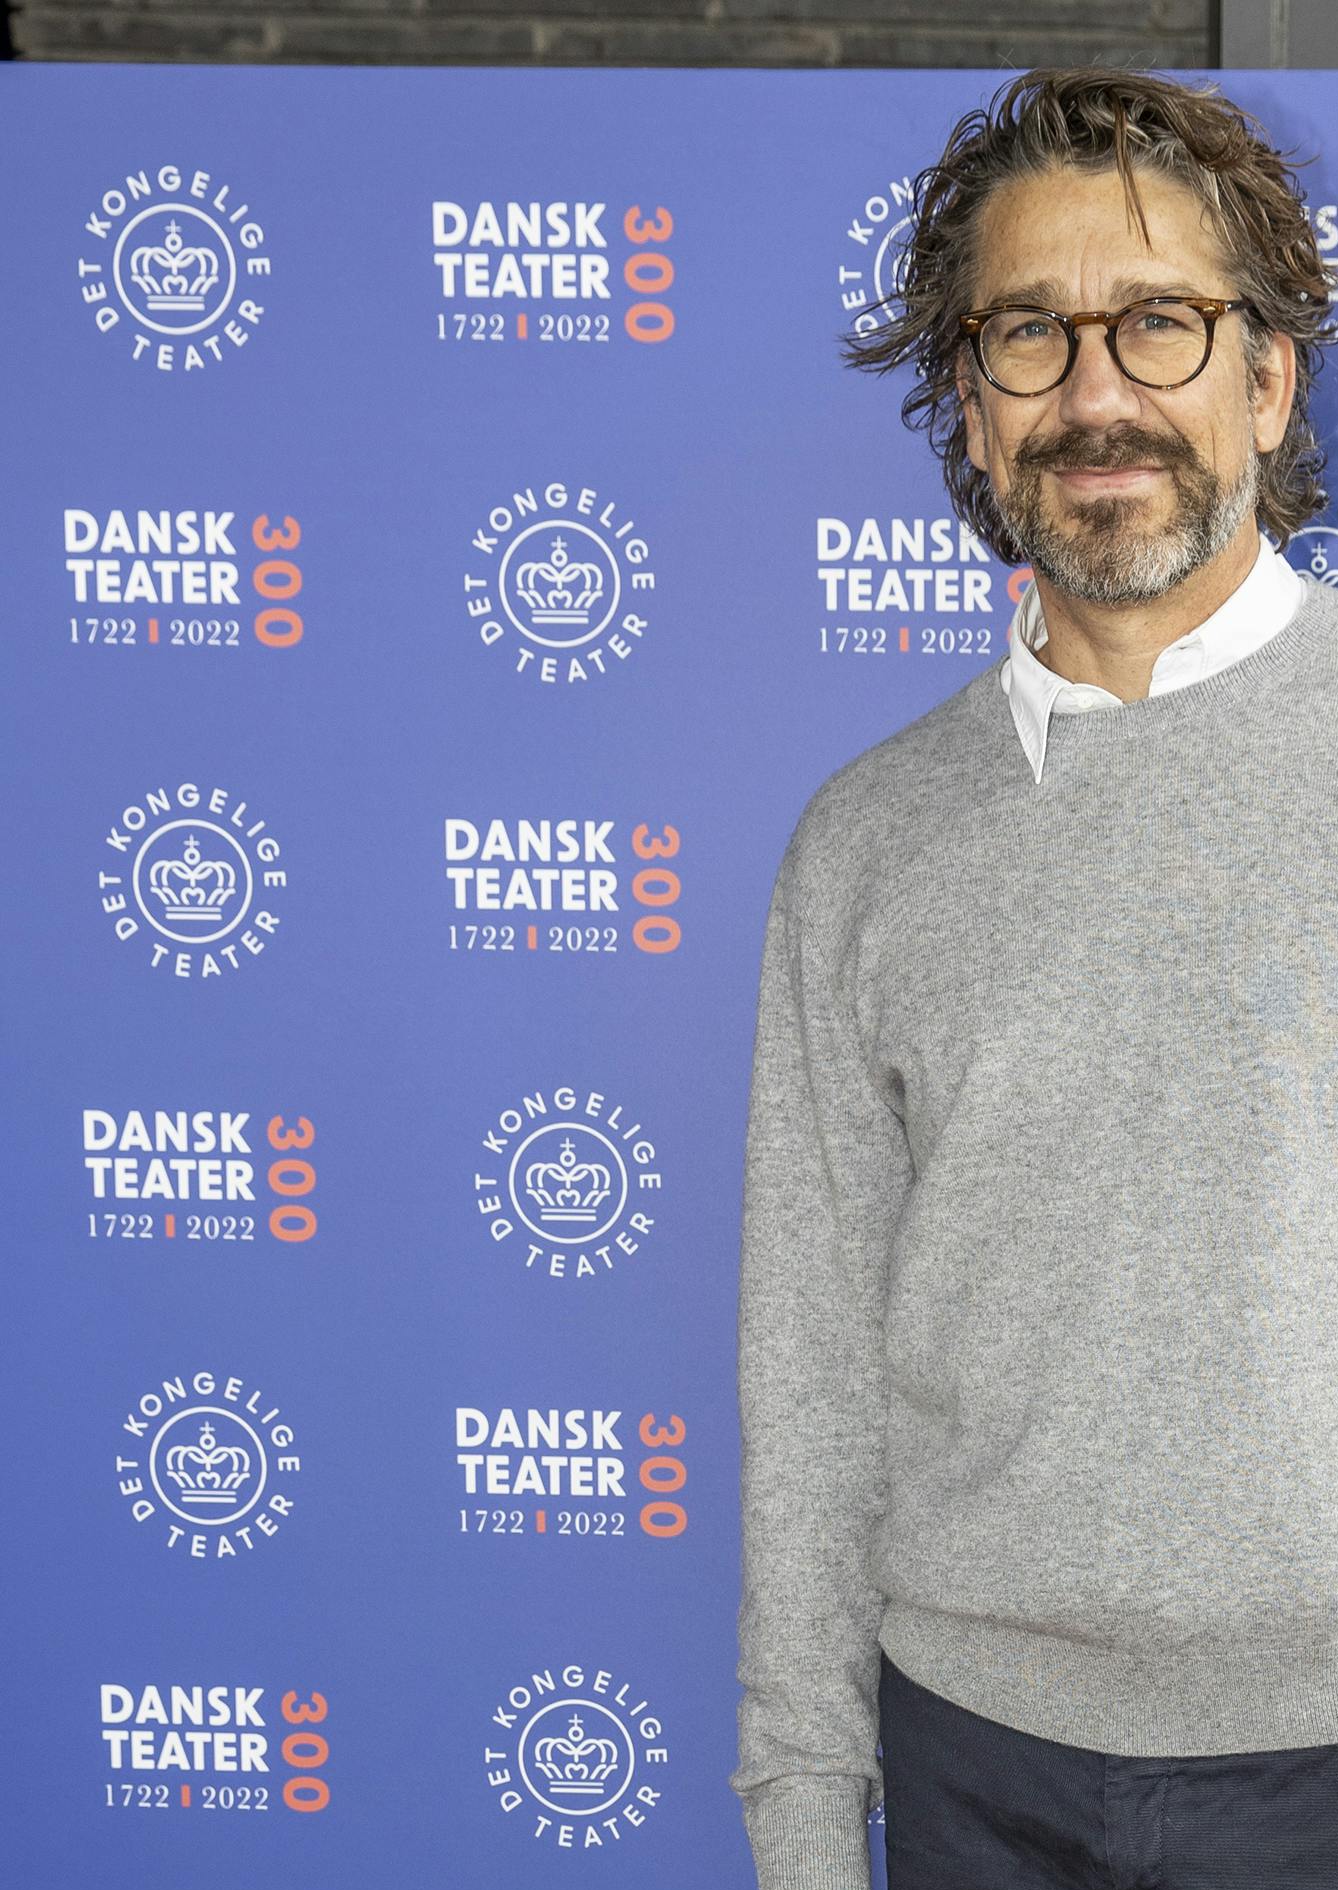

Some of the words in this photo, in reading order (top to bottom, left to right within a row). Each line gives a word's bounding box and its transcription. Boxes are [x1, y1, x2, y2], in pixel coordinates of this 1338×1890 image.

[85, 165, 271, 275] KONGELIGE
[431, 201, 608, 248] DANSK
[78, 258, 120, 333] DET
[433, 252, 612, 299] TEATER
[623, 205, 676, 344] 300
[132, 299, 265, 372] TEATER
[437, 313, 505, 341] 1722
[538, 314, 610, 342] 2022
[63, 508, 237, 556] DANSK
[471, 482, 655, 590] KONGELIGE
[65, 558, 241, 605] TEATER
[251, 513, 304, 649] 300
[817, 567, 993, 612] TEATER
[70, 617, 137, 645] 1722
[169, 619, 240, 646] 2022
[464, 573, 505, 646] DET
[516, 613, 648, 683] TEATER
[820, 627, 887, 654] 1722
[921, 628, 992, 655] 2022
[105, 782, 287, 887] KONGELIGE
[444, 818, 616, 863] DANSK
[98, 870, 139, 941] DET
[446, 867, 620, 912] TEATER
[631, 823, 682, 954] 300
[150, 910, 281, 978] TEATER
[449, 925, 515, 951] 1722
[548, 926, 618, 953] 2022
[82, 1109, 253, 1154] DANSK
[84, 1156, 256, 1201] TEATER
[266, 1114, 318, 1243] 300
[88, 1213, 154, 1239] 1722
[186, 1215, 255, 1241] 2022
[455, 1407, 624, 1451] DANSK
[456, 1453, 627, 1497] TEATER
[638, 1412, 688, 1538] 300
[459, 1509, 524, 1534] 1722
[557, 1511, 625, 1537] 2022
[492, 1665, 668, 1763] KONGELIGE
[484, 1747, 523, 1813] DET
[534, 1785, 662, 1849] TEATER
